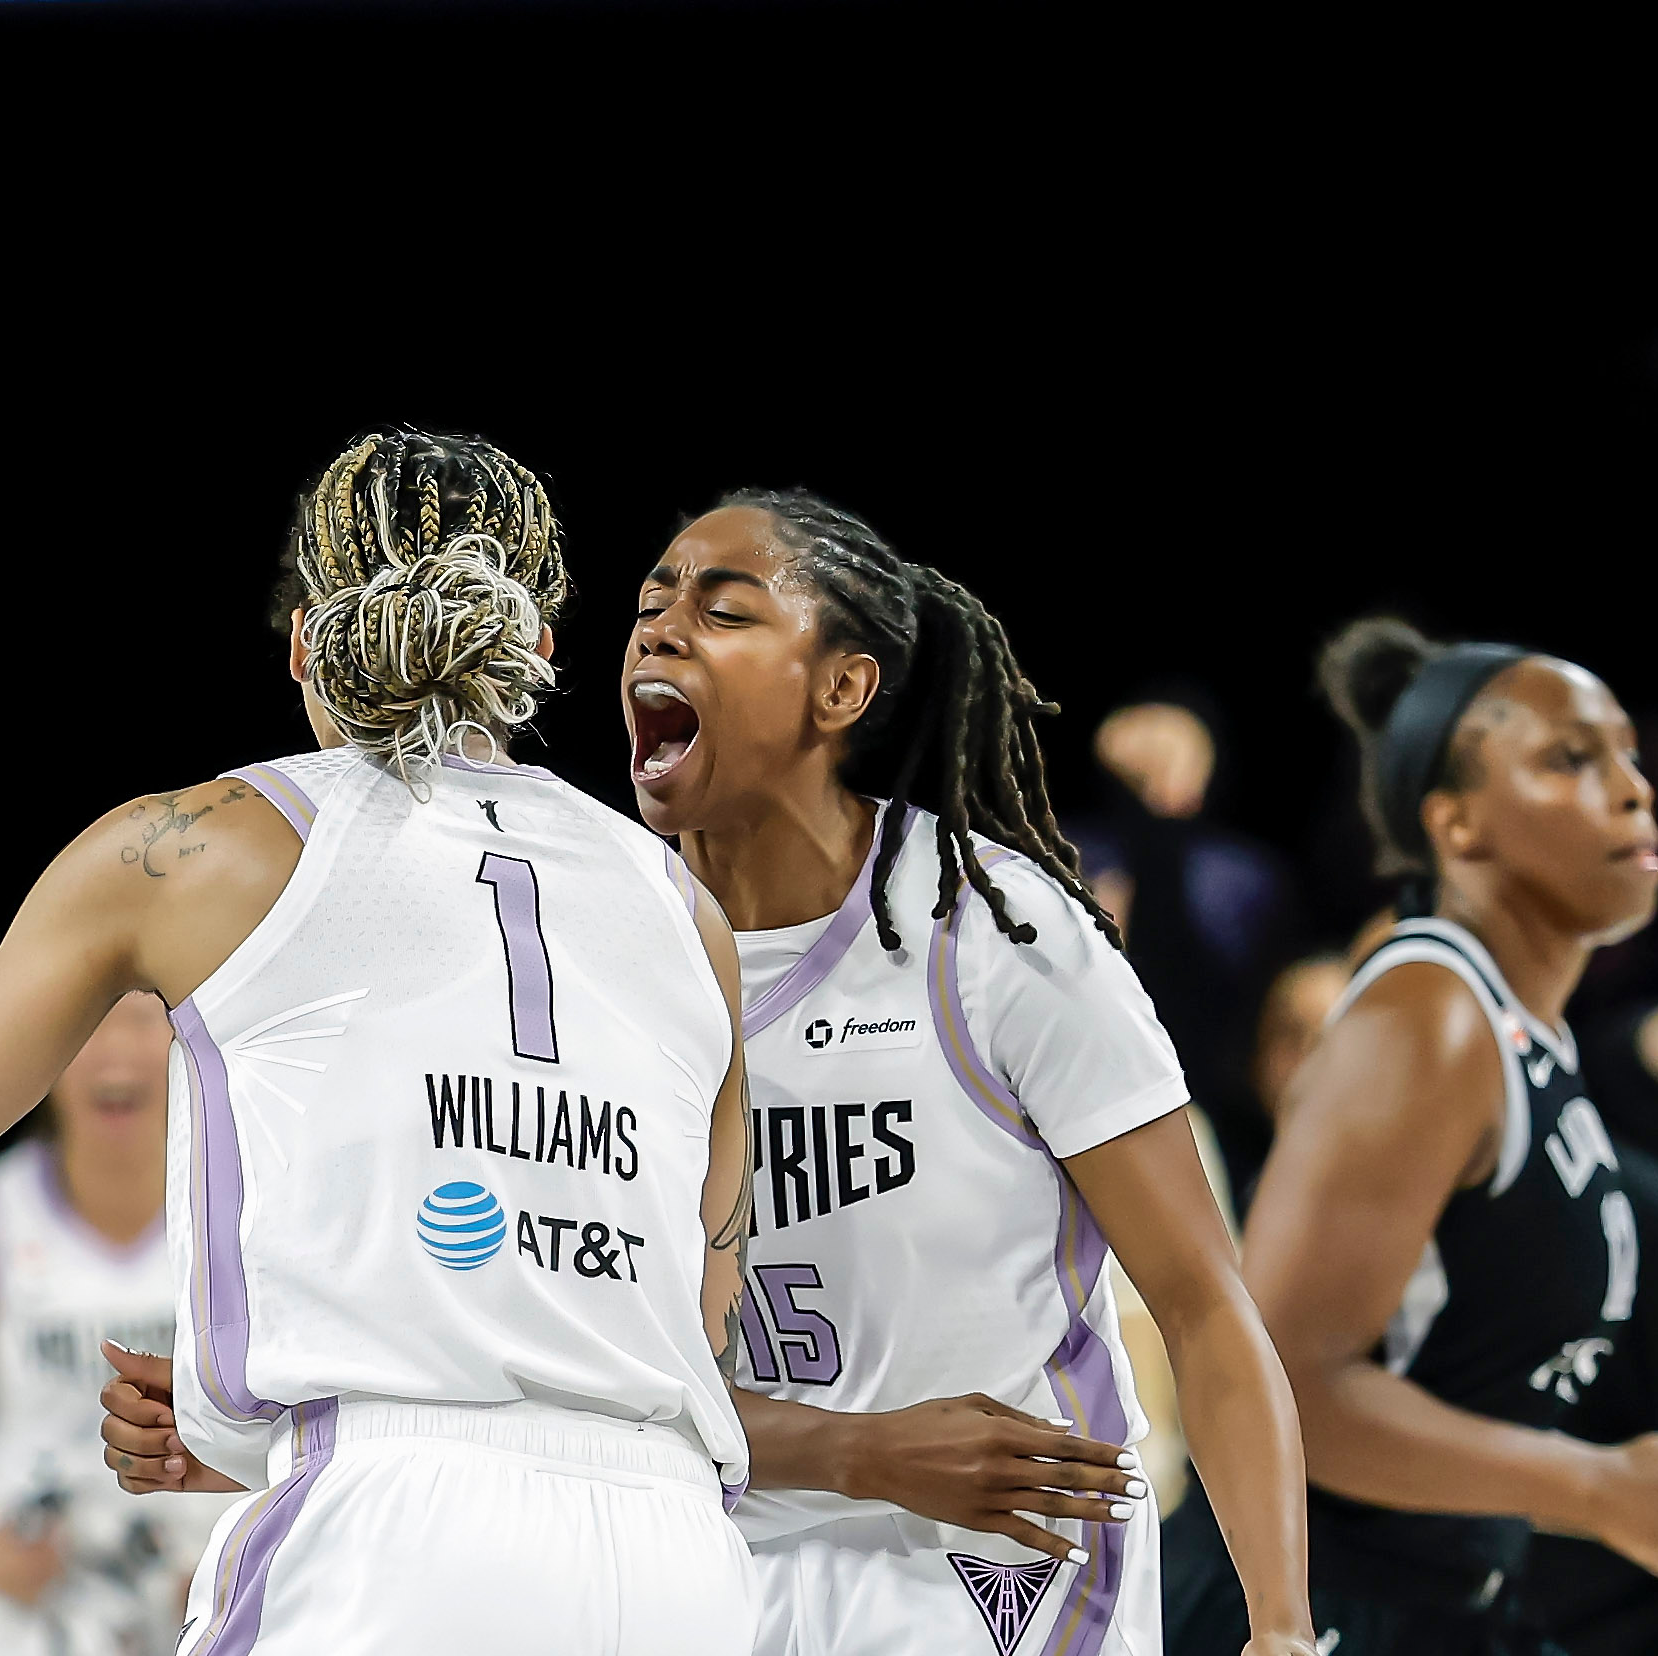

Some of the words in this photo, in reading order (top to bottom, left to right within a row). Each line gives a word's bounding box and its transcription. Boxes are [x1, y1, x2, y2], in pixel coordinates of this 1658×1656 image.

[475, 851, 560, 1065] 1
[840, 1017, 916, 1044] freedom
[425, 1071, 640, 1182] WILLIAMS
[516, 1208, 645, 1284] AT&T
